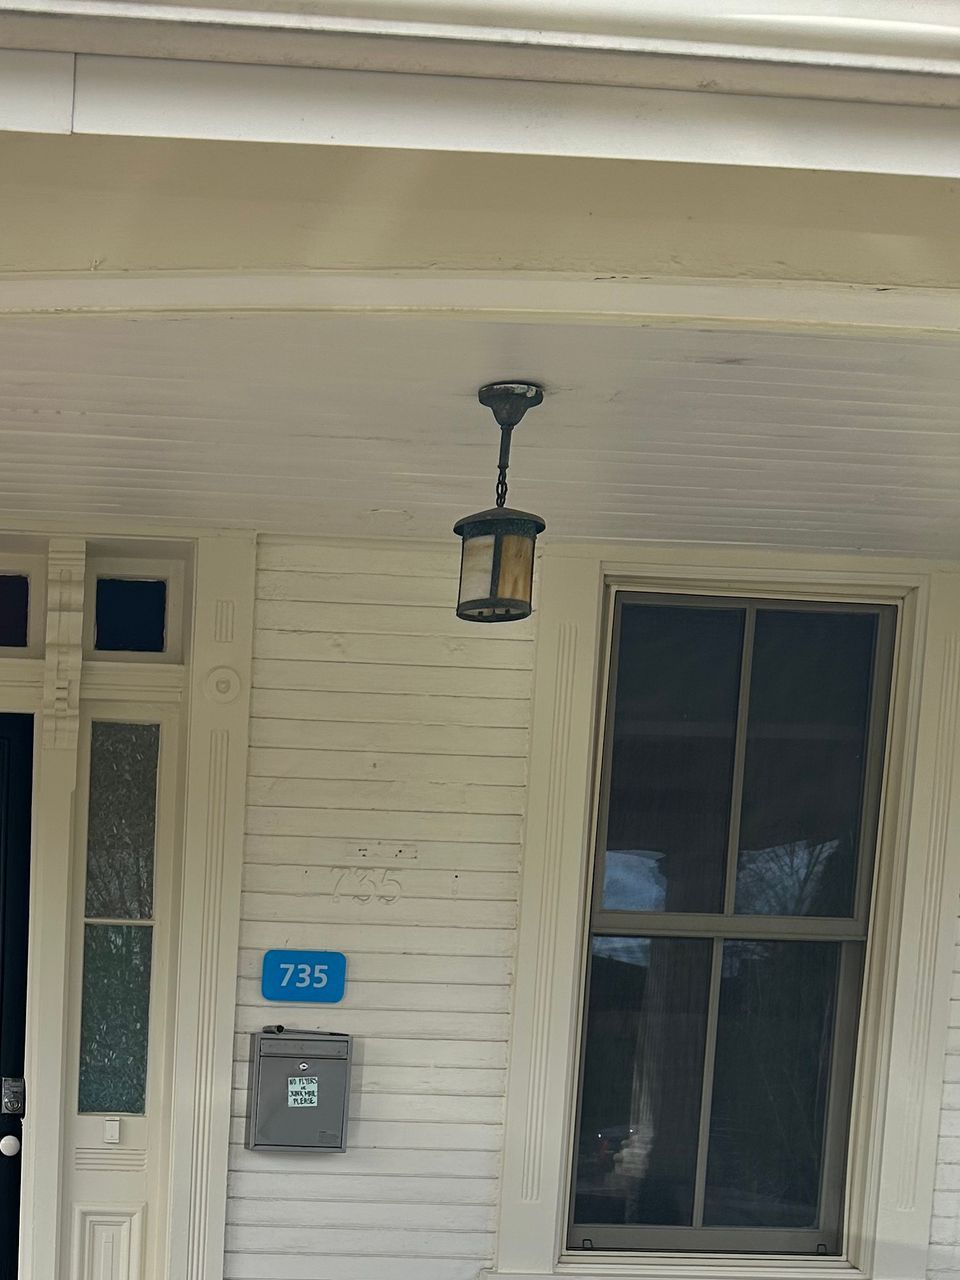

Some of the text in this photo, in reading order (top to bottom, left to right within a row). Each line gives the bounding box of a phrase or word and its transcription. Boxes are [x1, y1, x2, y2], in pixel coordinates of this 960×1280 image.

[330, 866, 402, 905] 735
[279, 963, 328, 988] 735
[293, 1097, 316, 1105] PLEASE
